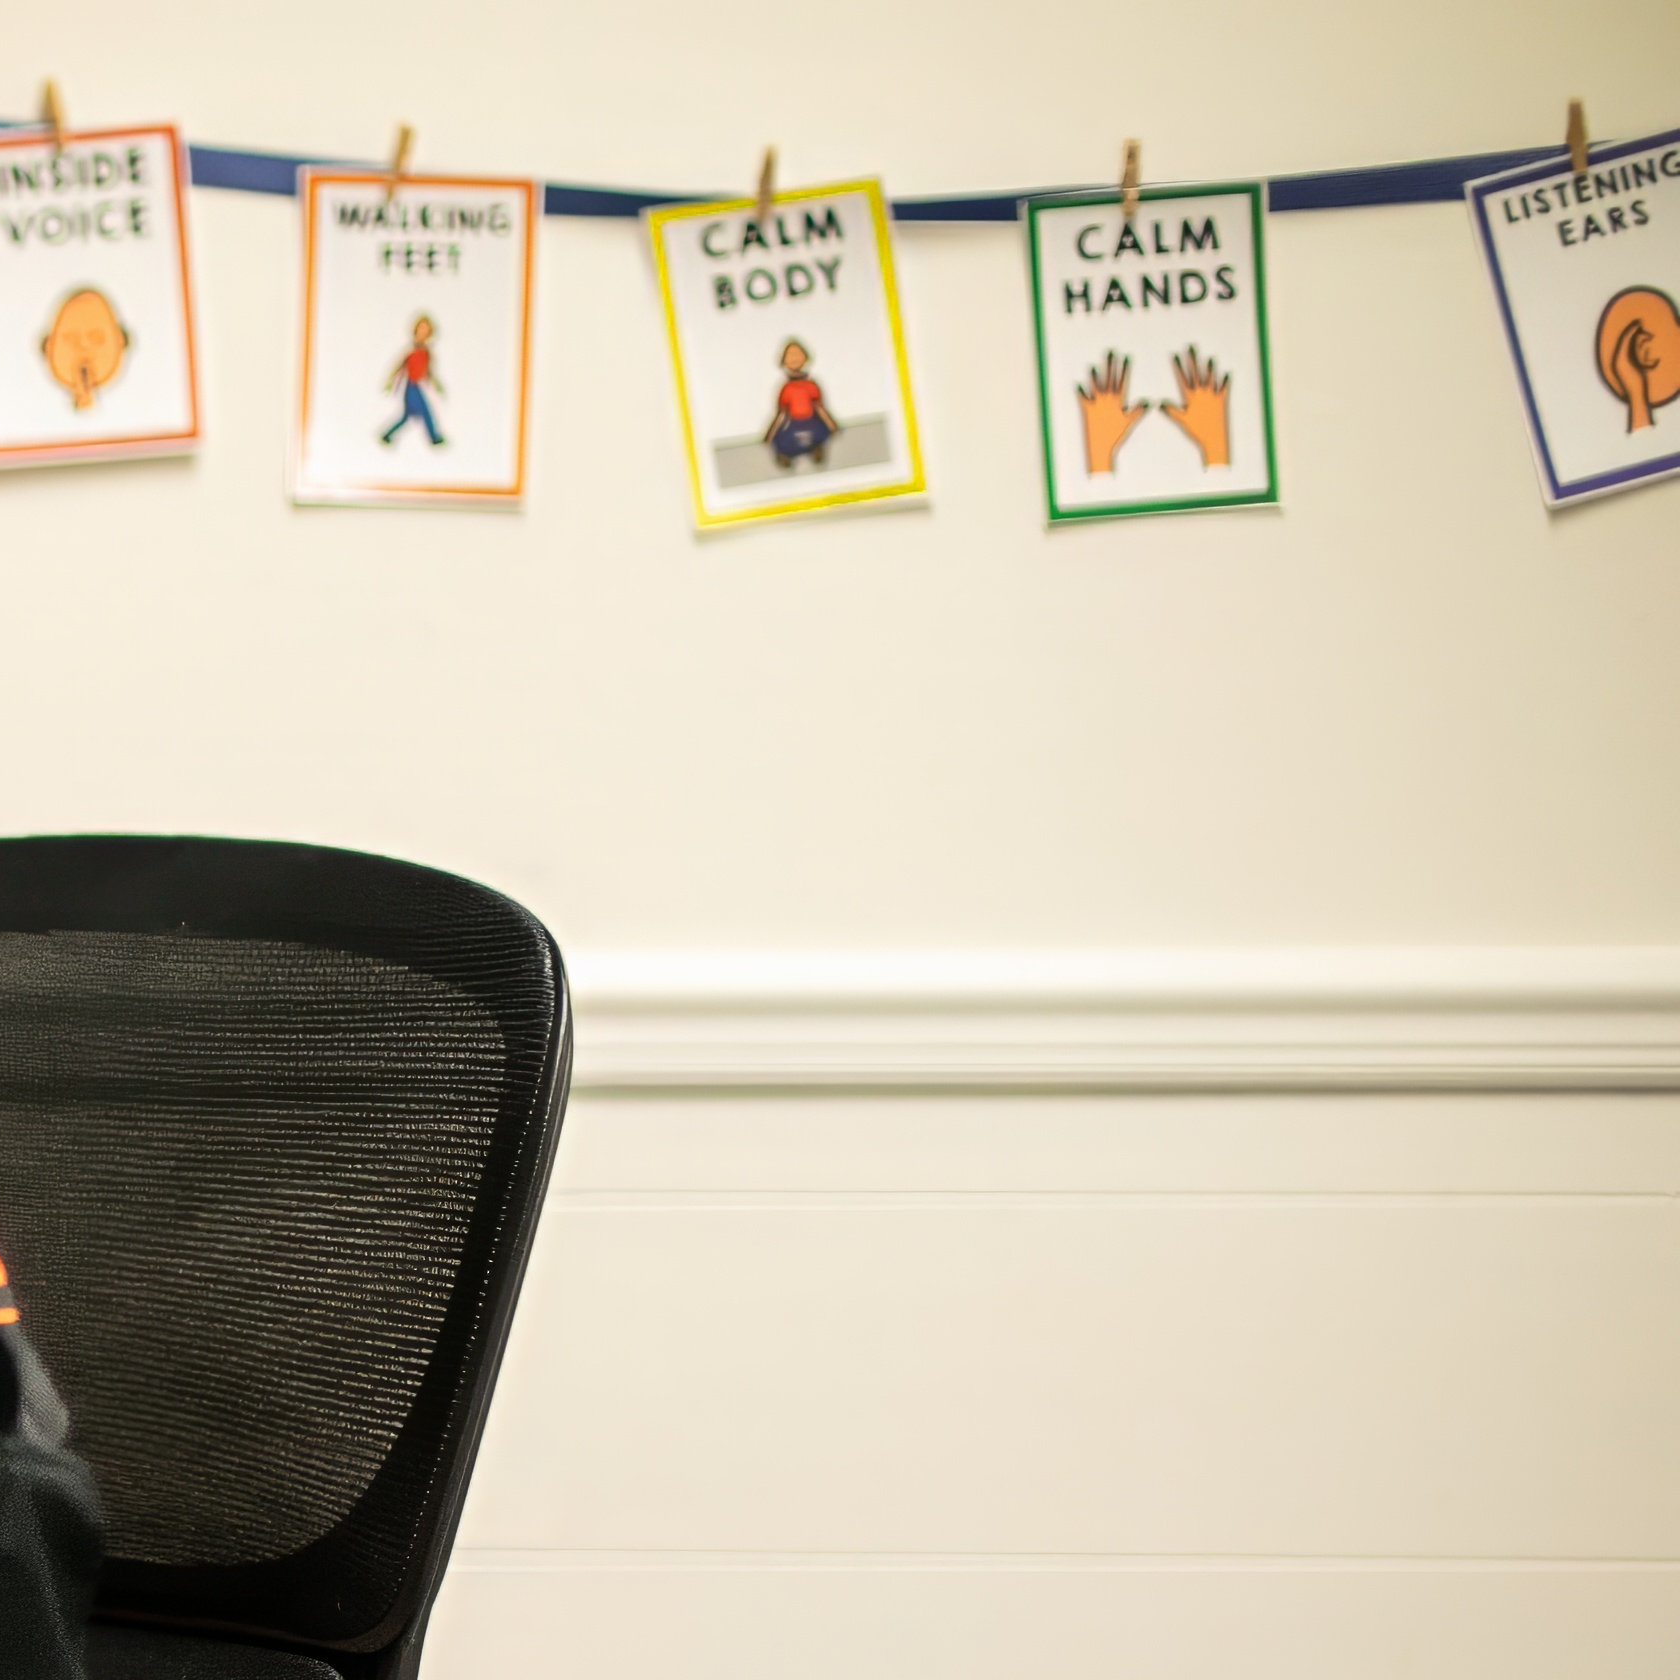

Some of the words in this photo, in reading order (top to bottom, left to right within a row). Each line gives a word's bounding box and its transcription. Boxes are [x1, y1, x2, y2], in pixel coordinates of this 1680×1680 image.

[1502, 150, 1680, 224] LISTENING
[334, 203, 512, 236] WALKING
[701, 206, 844, 259] CALM
[1077, 216, 1220, 260] CALM
[1556, 200, 1650, 247] EARS
[380, 243, 462, 277] FEET
[714, 256, 842, 310] BODY
[1064, 265, 1237, 314] HANDS
